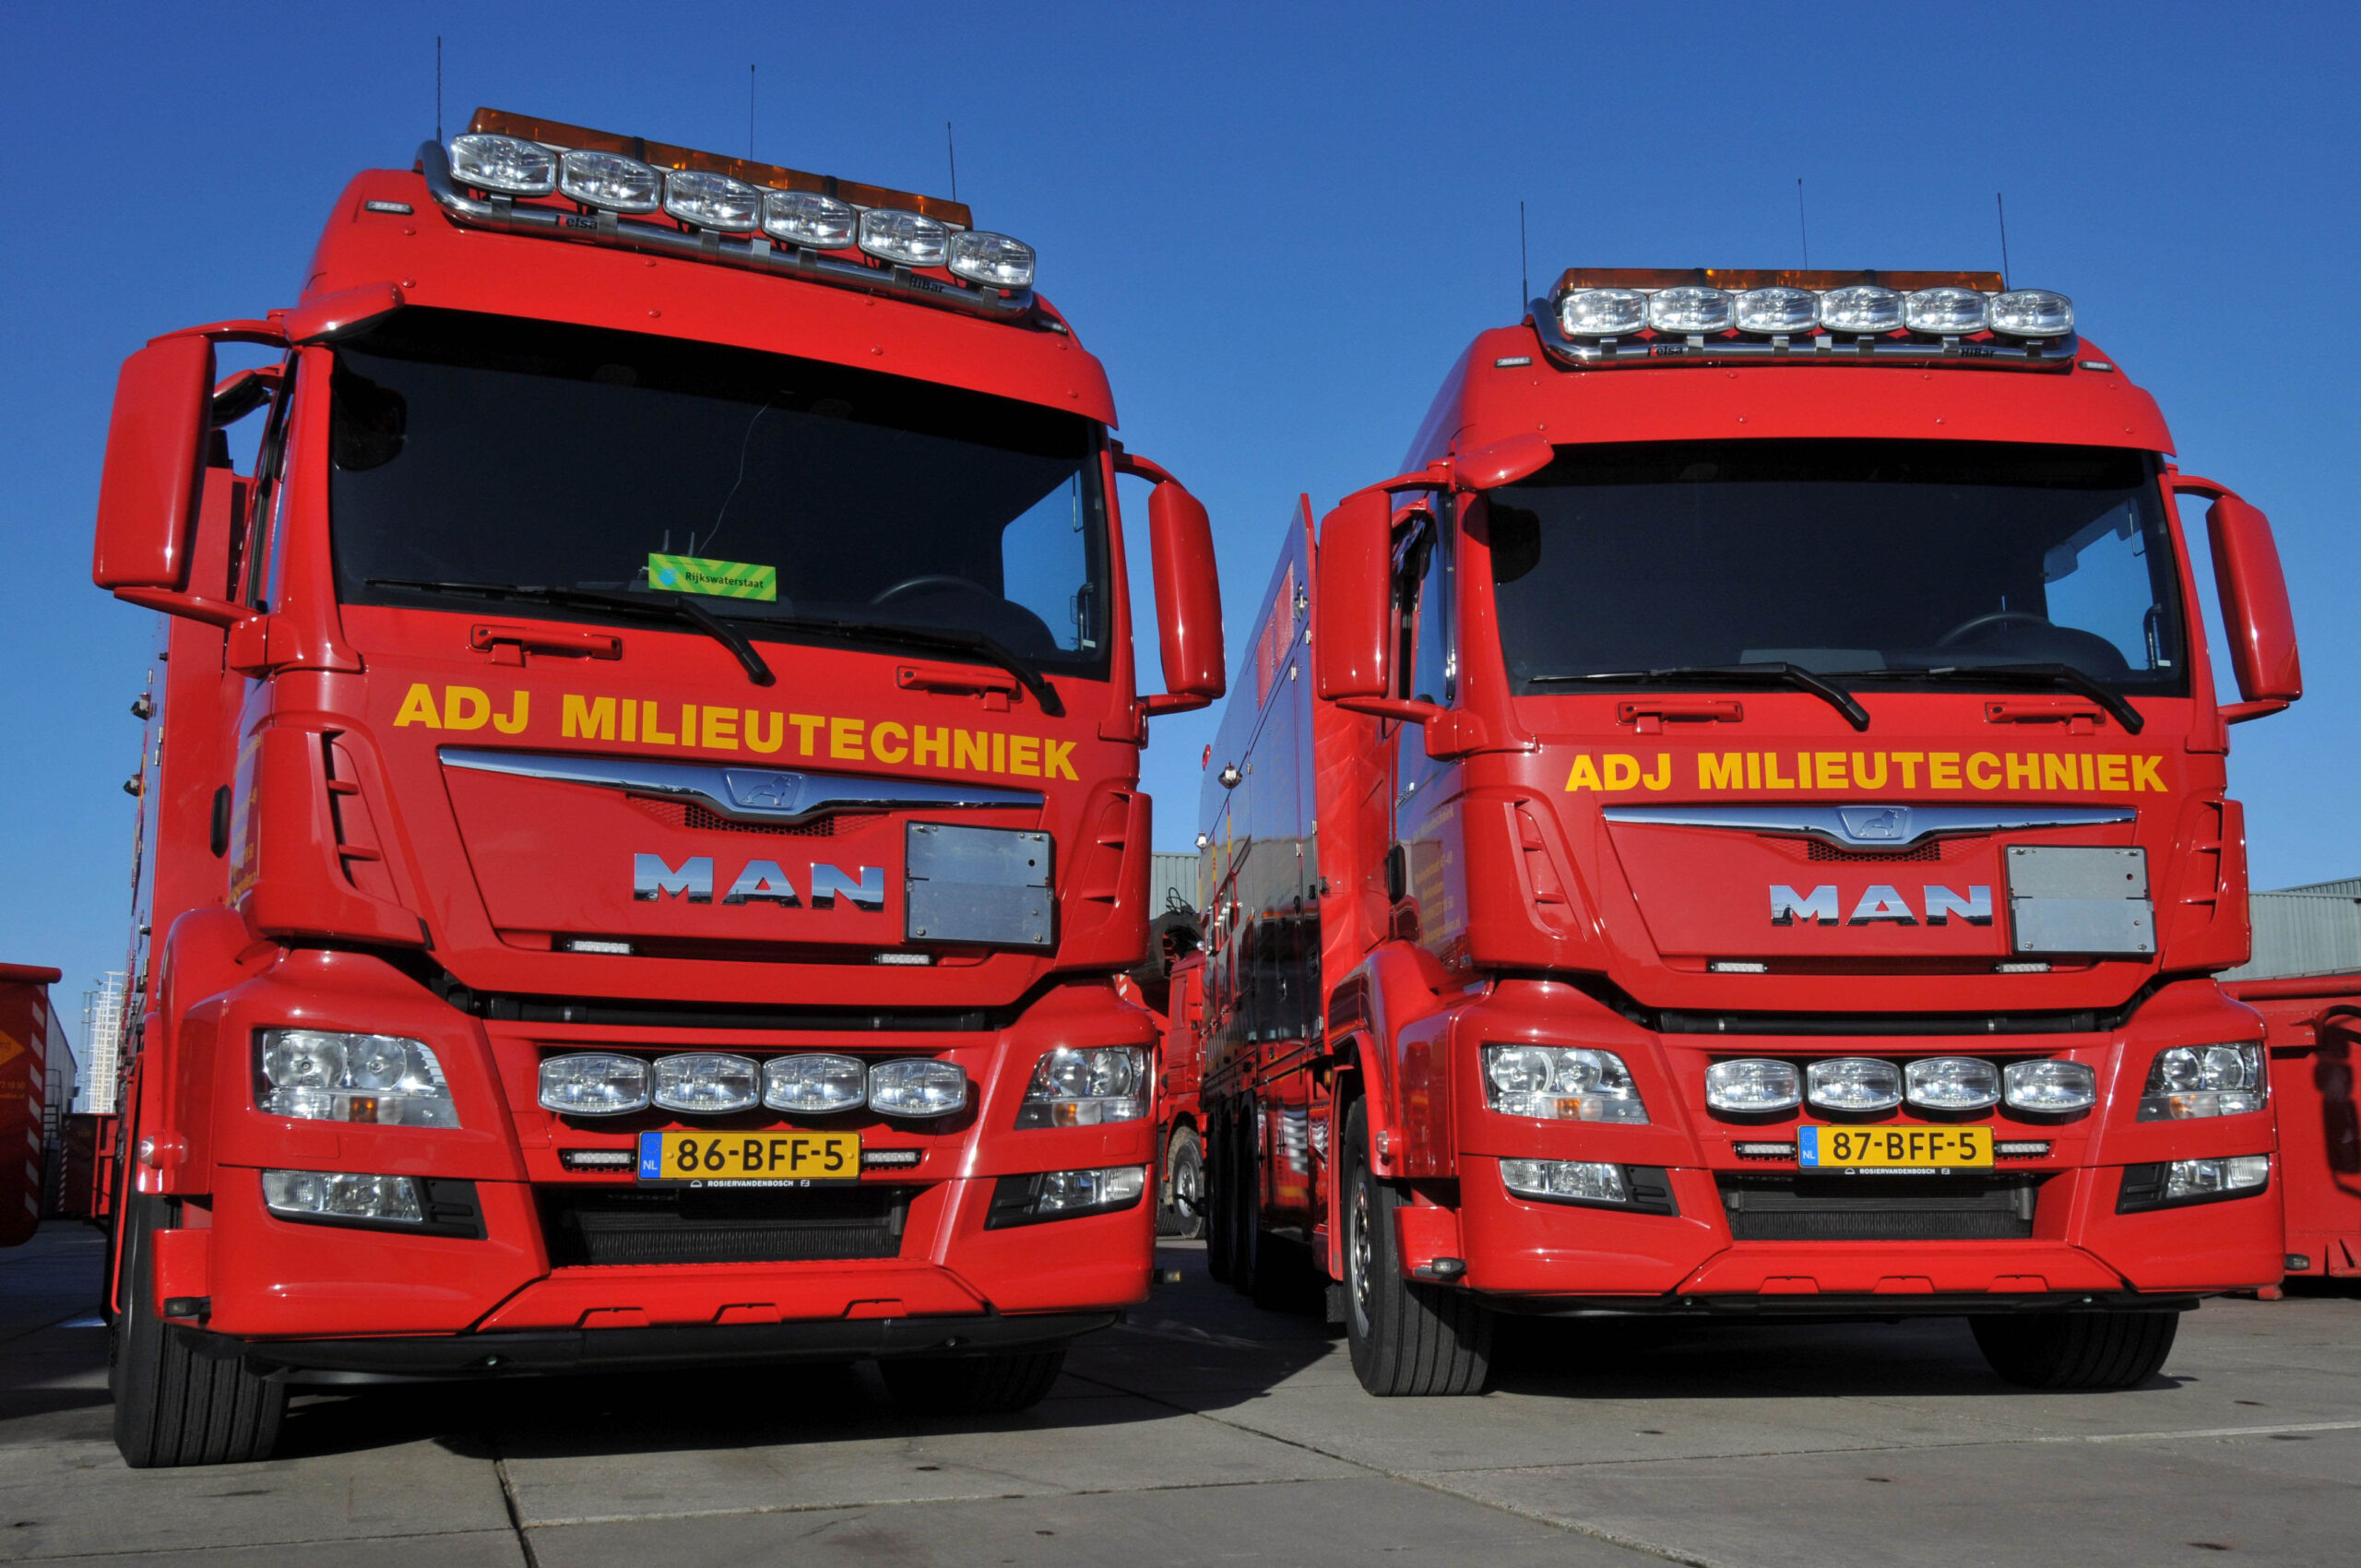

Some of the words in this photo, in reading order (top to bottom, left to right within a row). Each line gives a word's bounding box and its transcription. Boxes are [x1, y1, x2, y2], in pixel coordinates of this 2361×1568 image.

[685, 571, 765, 588] Rijkswaterstaat
[393, 683, 529, 734] ADJ
[561, 695, 1079, 781] MILIEUTECHNIEK
[1565, 754, 1672, 792] ADJ
[1697, 752, 2168, 792] MILIEUTECHNIEK
[633, 852, 885, 912] MAN
[1769, 884, 1994, 927] MAN
[643, 1160, 658, 1170] NL
[676, 1138, 844, 1172] 86-BFF-5
[1802, 1150, 1816, 1159] NL
[1833, 1132, 1977, 1161] 87-BFF-5
[706, 1180, 794, 1188] ROSIERVANDENBOSCH
